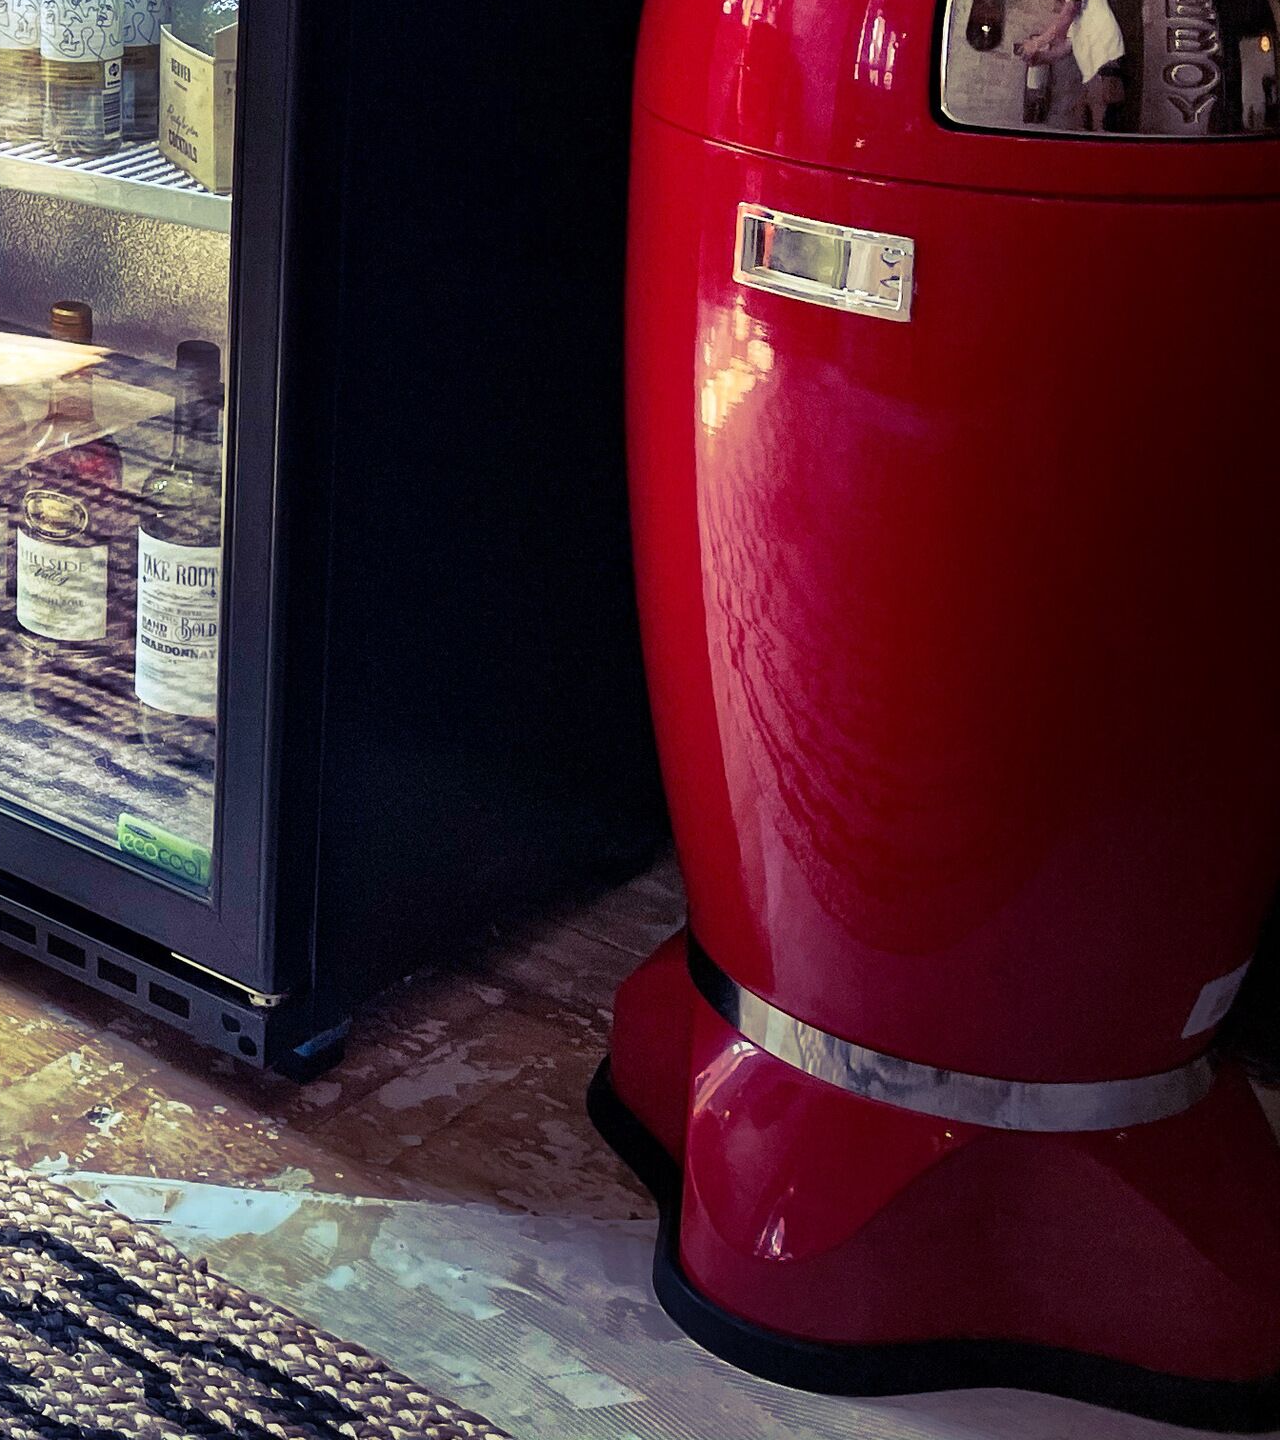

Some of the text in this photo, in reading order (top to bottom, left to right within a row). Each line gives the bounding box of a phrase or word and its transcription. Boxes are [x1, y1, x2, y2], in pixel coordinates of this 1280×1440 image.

[21, 549, 88, 573] HILLSIDE
[143, 552, 218, 588] TAKE ROOT
[34, 567, 70, 586] Valley
[175, 617, 217, 642] BOLD
[141, 634, 217, 660] CHARDONNAY
[123, 833, 202, 881] ecocool
